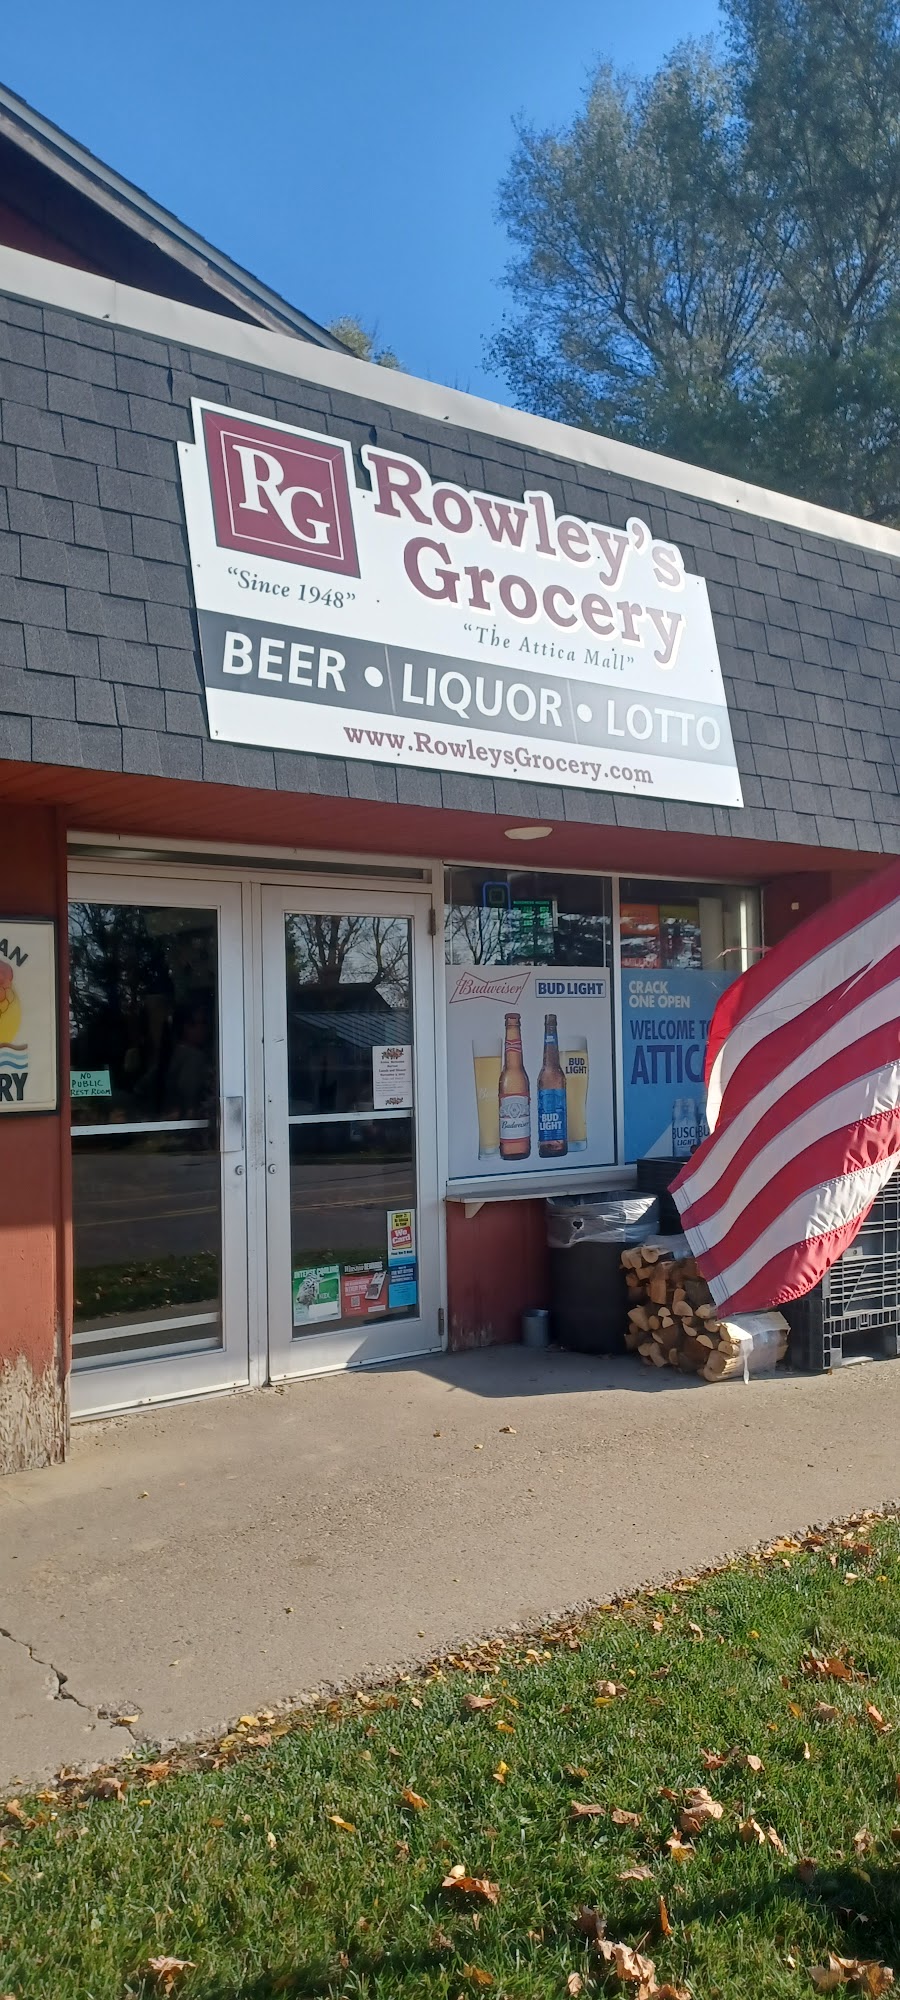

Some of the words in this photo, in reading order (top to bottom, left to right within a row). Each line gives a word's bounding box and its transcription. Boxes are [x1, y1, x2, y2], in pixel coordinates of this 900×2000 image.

[232, 444, 331, 544] RG
[367, 452, 681, 587] Rowley’s
[227, 566, 290, 598] “Since
[297, 584, 356, 608] 1948”
[403, 536, 682, 665] Grocery
[463, 623, 511, 649] “The
[518, 637, 576, 662] Attica
[583, 649, 634, 671] Mall”
[222, 630, 347, 692] BEER
[402, 663, 563, 727] LIQUOR
[606, 699, 722, 751] LOTTO
[343, 726, 654, 785] www.RowleysGrocery.com
[456, 979, 523, 995] Budweiser
[538, 982, 566, 995] BUD
[567, 983, 604, 995] LIGHT
[628, 980, 669, 994] CRACK
[628, 995, 655, 1008] ONE
[658, 995, 690, 1009] OPEN
[629, 1019, 695, 1040] WELCOME
[568, 1057, 585, 1066] BUD
[630, 1044, 708, 1085] ATTIC
[565, 1066, 588, 1075] LIGHT
[71, 1080, 104, 1089] PUBLIC
[91, 1088, 111, 1096] ROOM
[541, 1113, 559, 1122] BUD
[540, 1121, 562, 1131] LIGHT
[392, 1233, 411, 1245] Card
